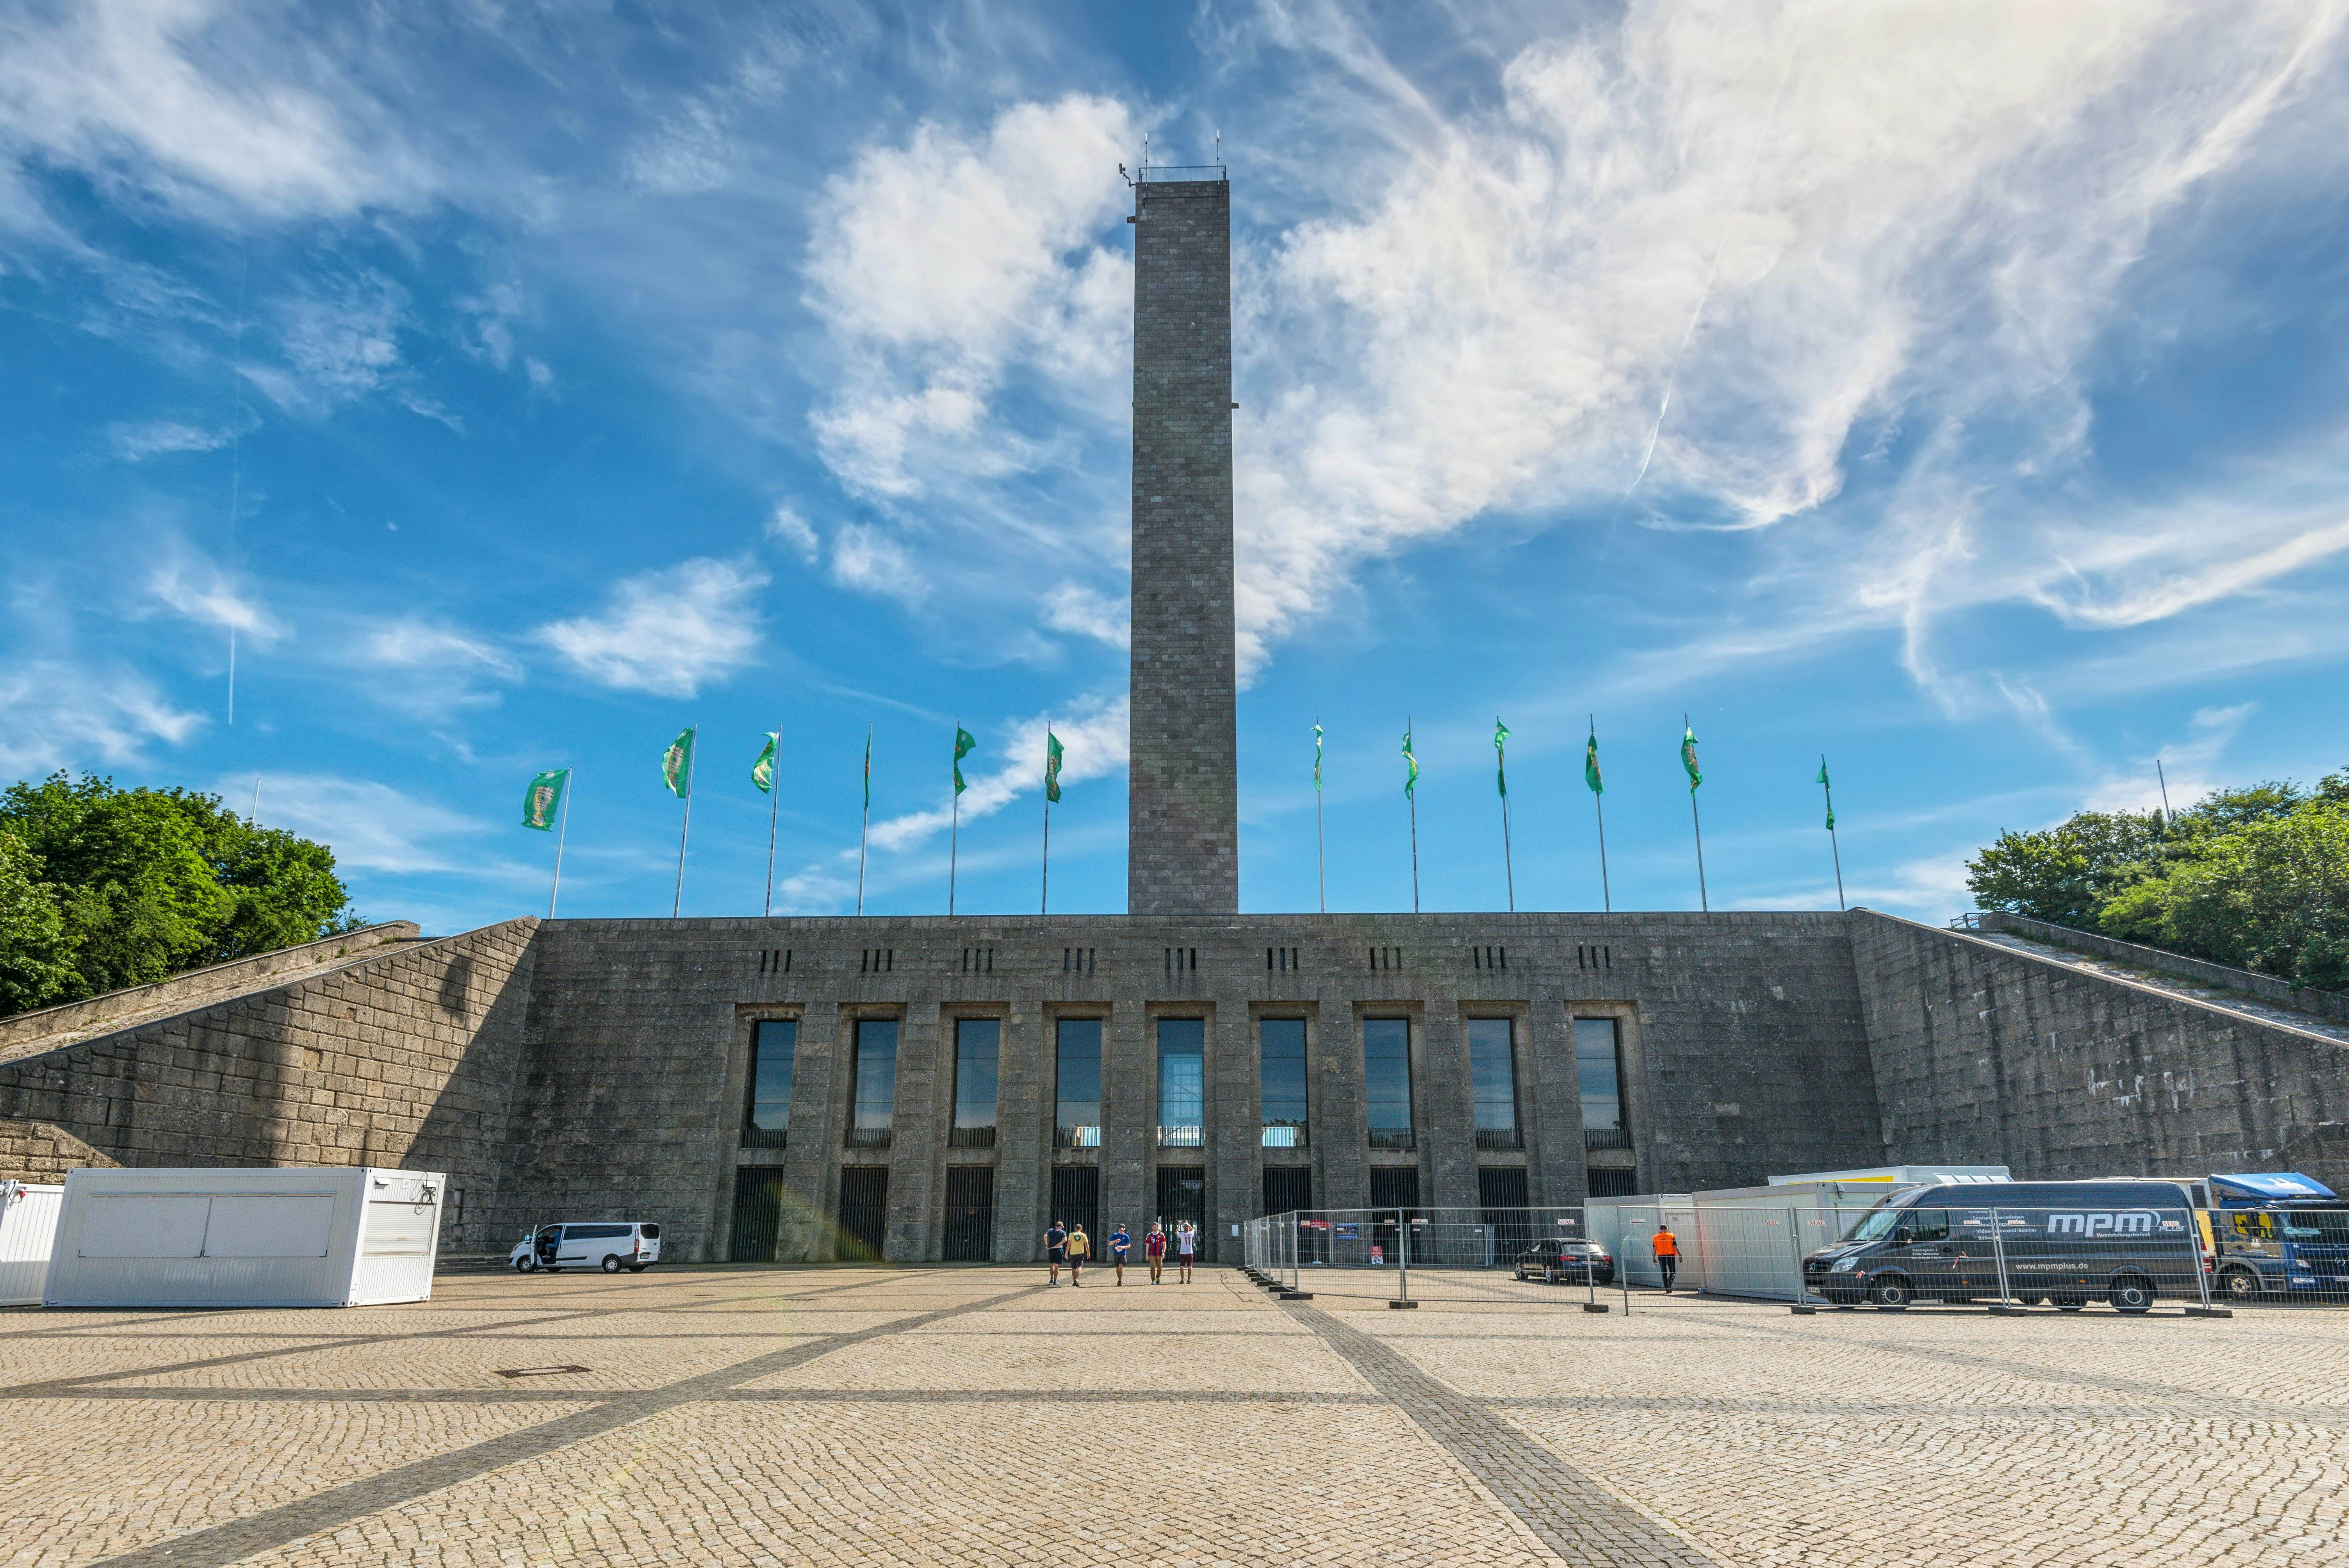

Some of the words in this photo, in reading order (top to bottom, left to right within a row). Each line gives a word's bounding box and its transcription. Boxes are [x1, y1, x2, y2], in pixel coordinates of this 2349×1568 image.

[2047, 1213, 2151, 1237] mpm
[1185, 1237, 1190, 1245] 11
[2015, 1262, 2089, 1270] www.mpmplus.de
